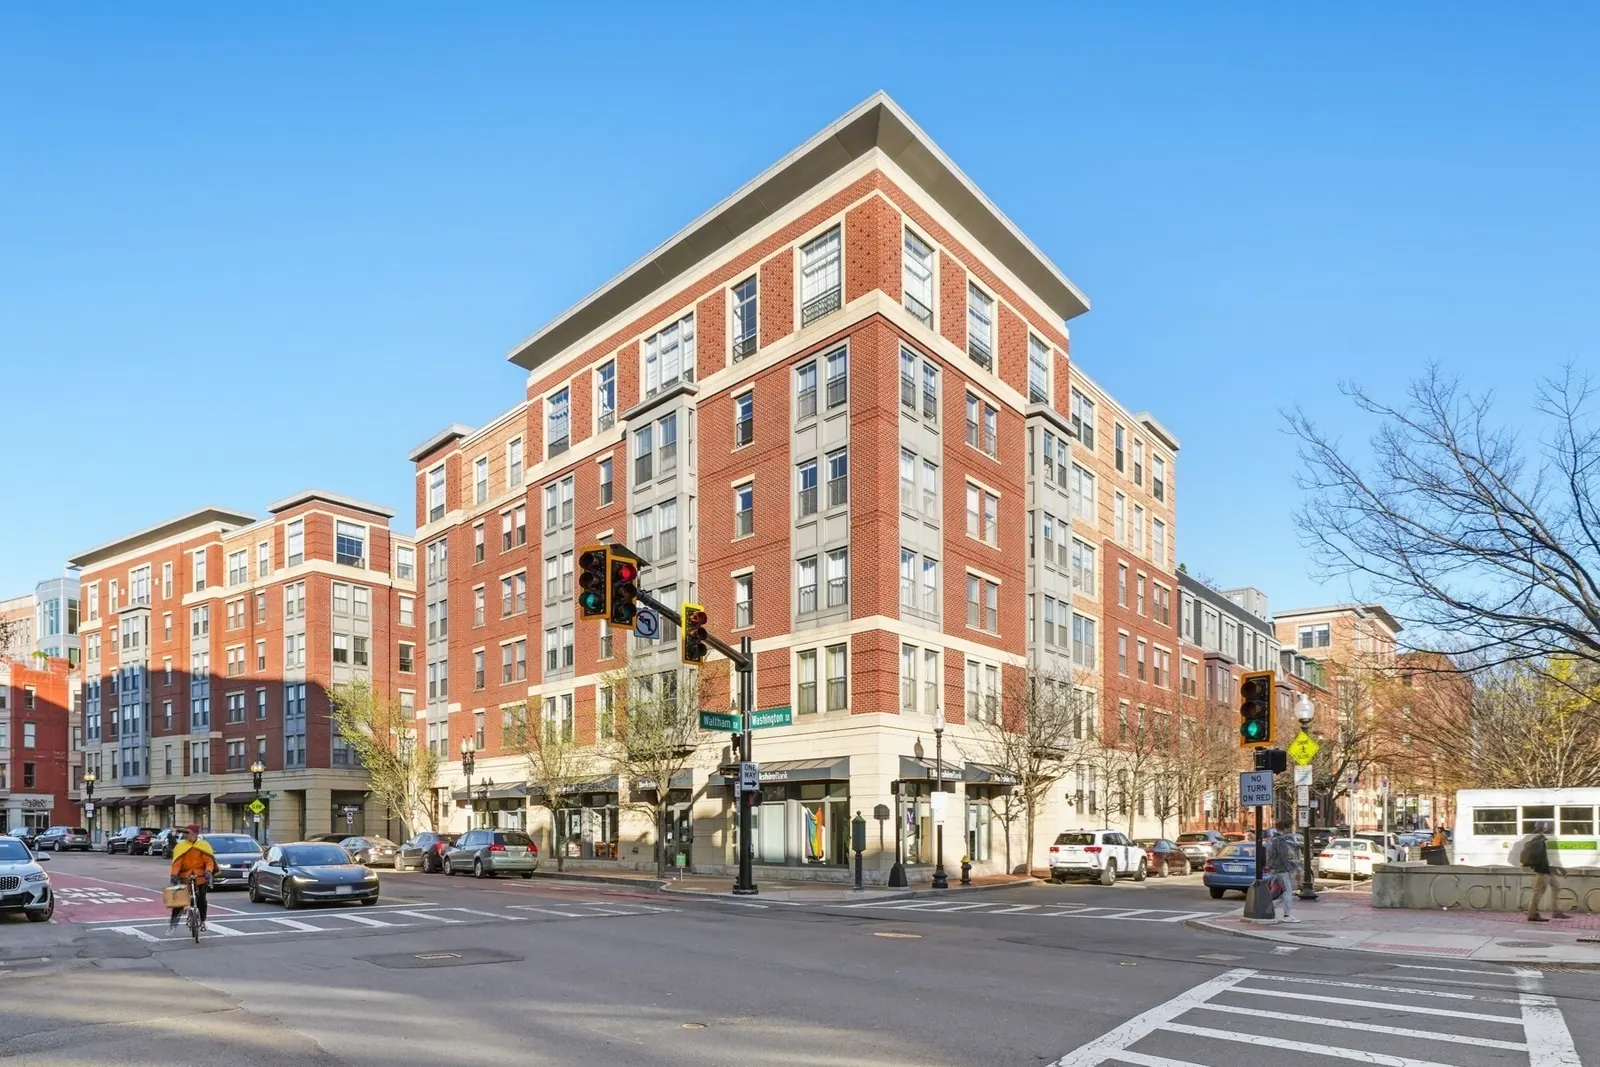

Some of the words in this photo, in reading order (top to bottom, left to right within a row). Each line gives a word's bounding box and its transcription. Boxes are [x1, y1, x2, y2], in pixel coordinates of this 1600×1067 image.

[703, 715, 730, 728] Waltham
[752, 713, 783, 726] Washington
[1247, 784, 1267, 792] TURN
[1243, 794, 1253, 802] ON
[1256, 793, 1271, 801] RED
